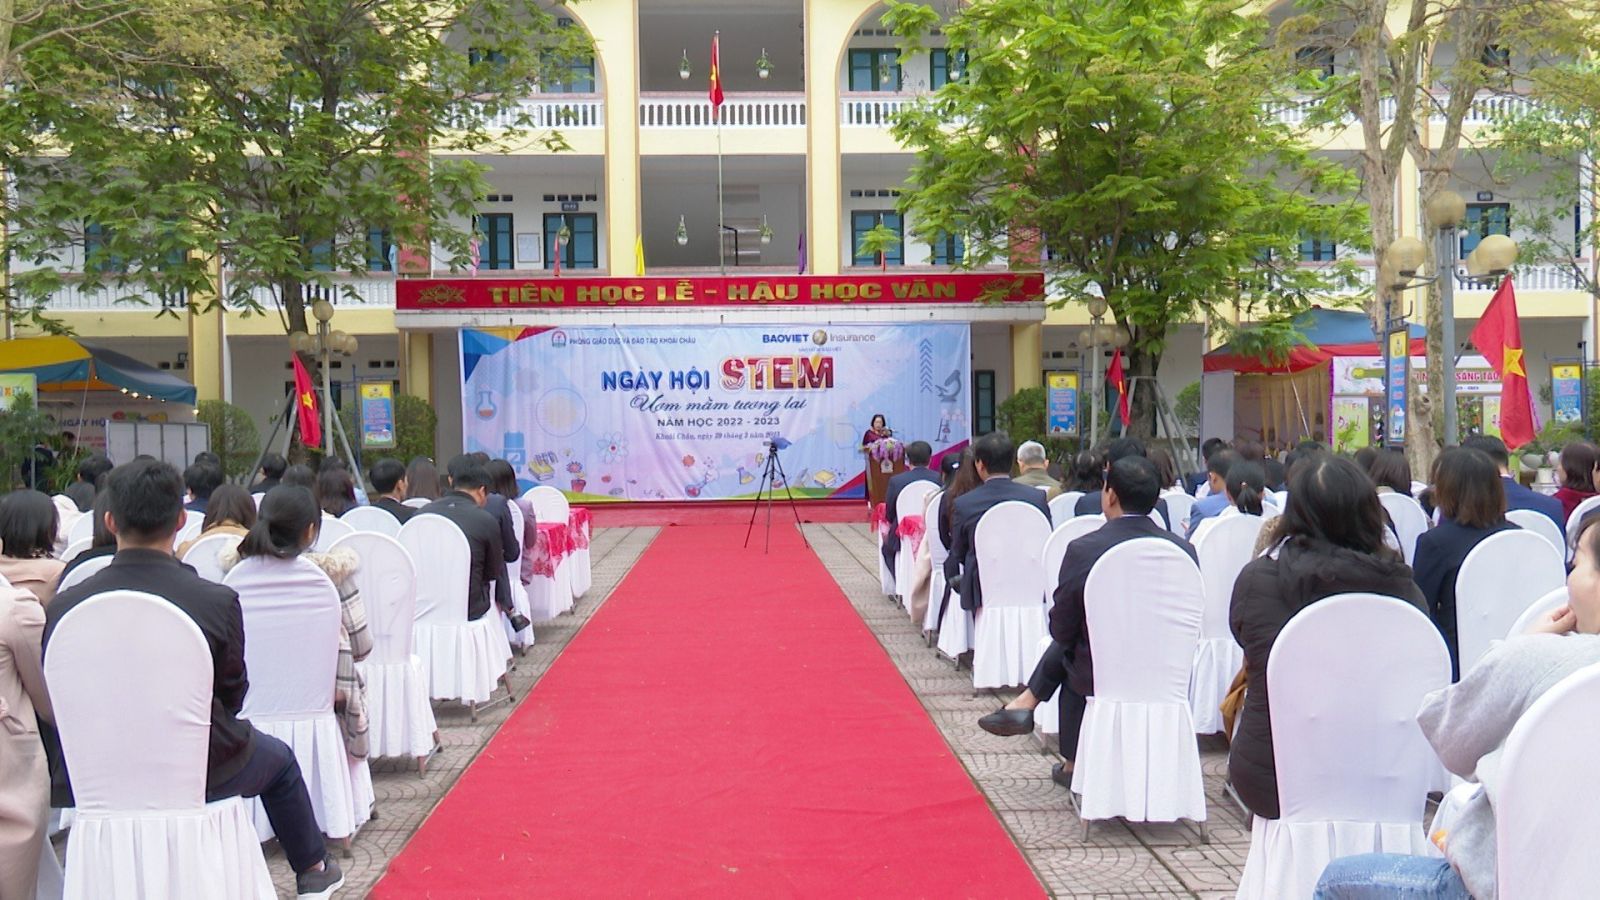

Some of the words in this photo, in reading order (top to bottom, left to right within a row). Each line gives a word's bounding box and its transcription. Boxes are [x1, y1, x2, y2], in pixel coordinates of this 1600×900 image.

[488, 282, 564, 303] TIÊN
[577, 285, 645, 305] HỌC
[656, 280, 695, 301] LỄ
[727, 281, 799, 304] HẬU
[811, 282, 882, 302] HỌC
[891, 279, 956, 299] VĂN
[762, 334, 809, 344] BAOVIET
[830, 333, 876, 342] Insurance
[601, 366, 663, 391] NGÀY
[668, 366, 710, 395] HỘI
[720, 355, 835, 393] STEM
[784, 396, 808, 410] lai
[657, 416, 684, 427] NĂM
[687, 417, 713, 428] HỌC
[717, 417, 743, 426] 2022
[754, 417, 780, 425] 2023
